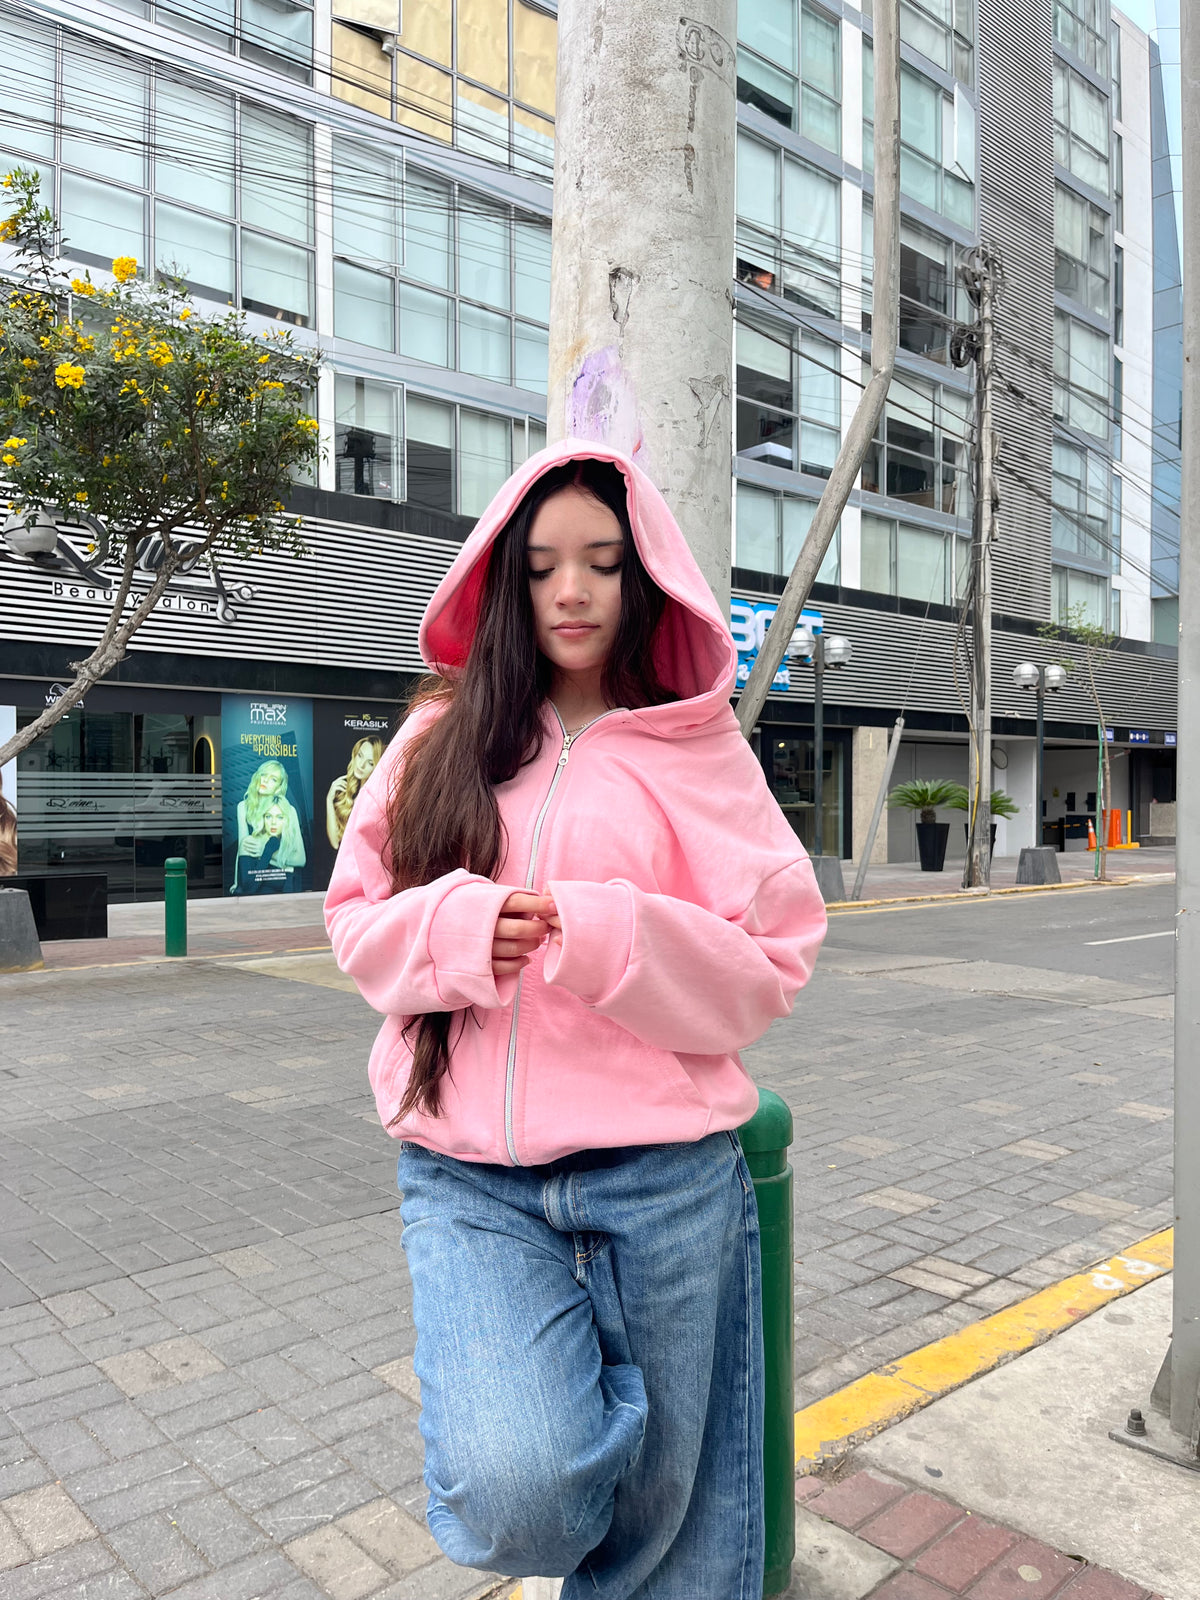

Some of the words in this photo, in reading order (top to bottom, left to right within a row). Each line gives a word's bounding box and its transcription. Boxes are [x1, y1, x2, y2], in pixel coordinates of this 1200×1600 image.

[53, 582, 140, 608] Beauy
[250, 708, 287, 721] max
[344, 719, 389, 728] KERASILK
[240, 733, 282, 745] EVERYTHING
[258, 743, 298, 757] POSSIBLE
